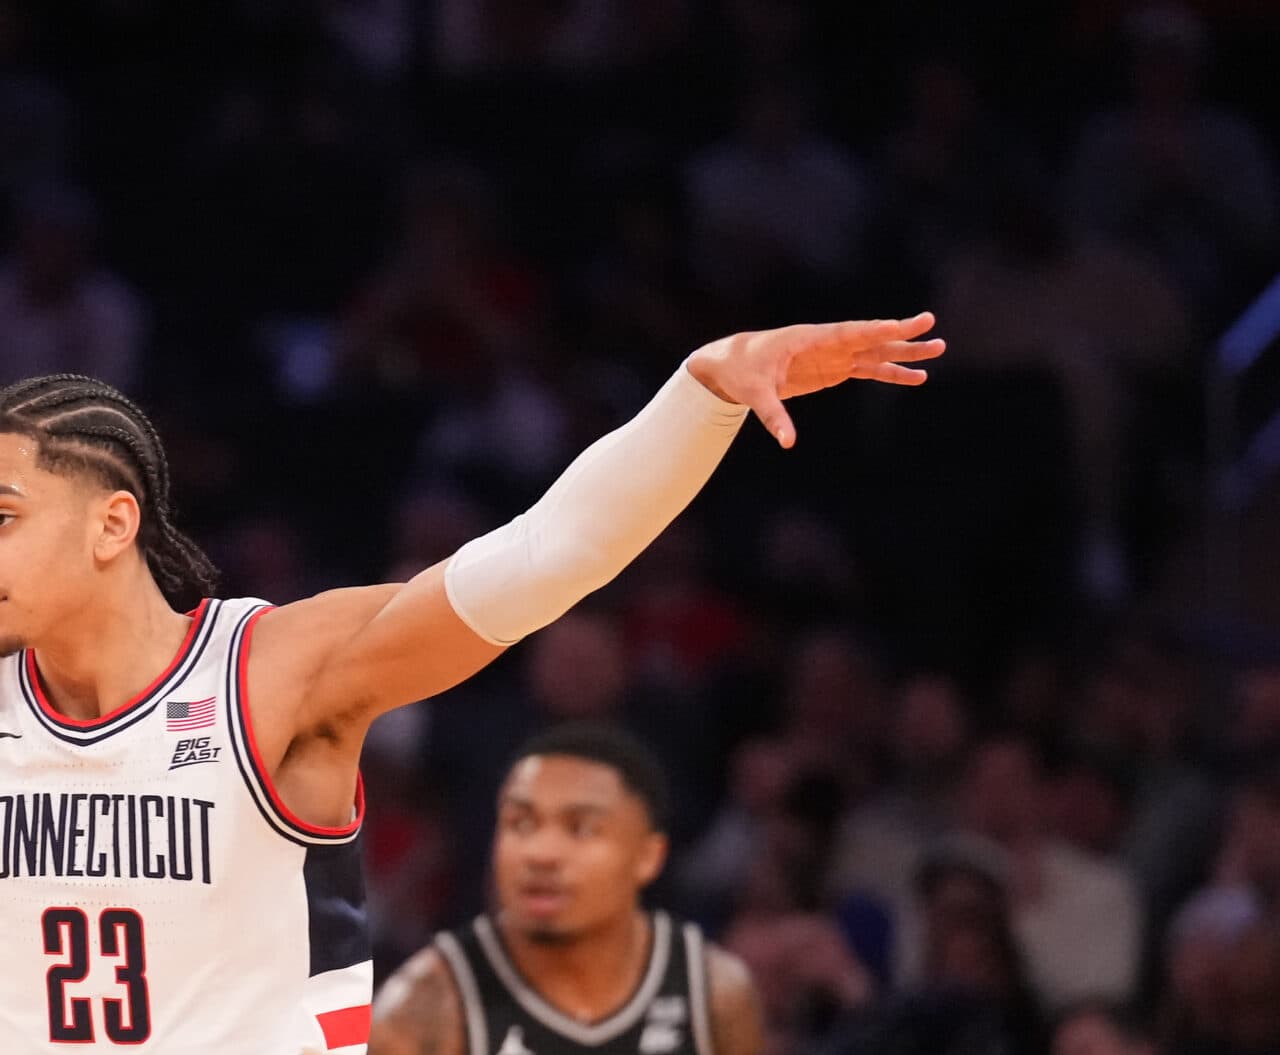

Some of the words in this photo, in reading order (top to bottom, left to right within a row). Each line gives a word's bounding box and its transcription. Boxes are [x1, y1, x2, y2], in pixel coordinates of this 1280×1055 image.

[175, 737, 211, 752] BIG
[171, 748, 222, 763] EAST
[41, 906, 152, 1045] 23
